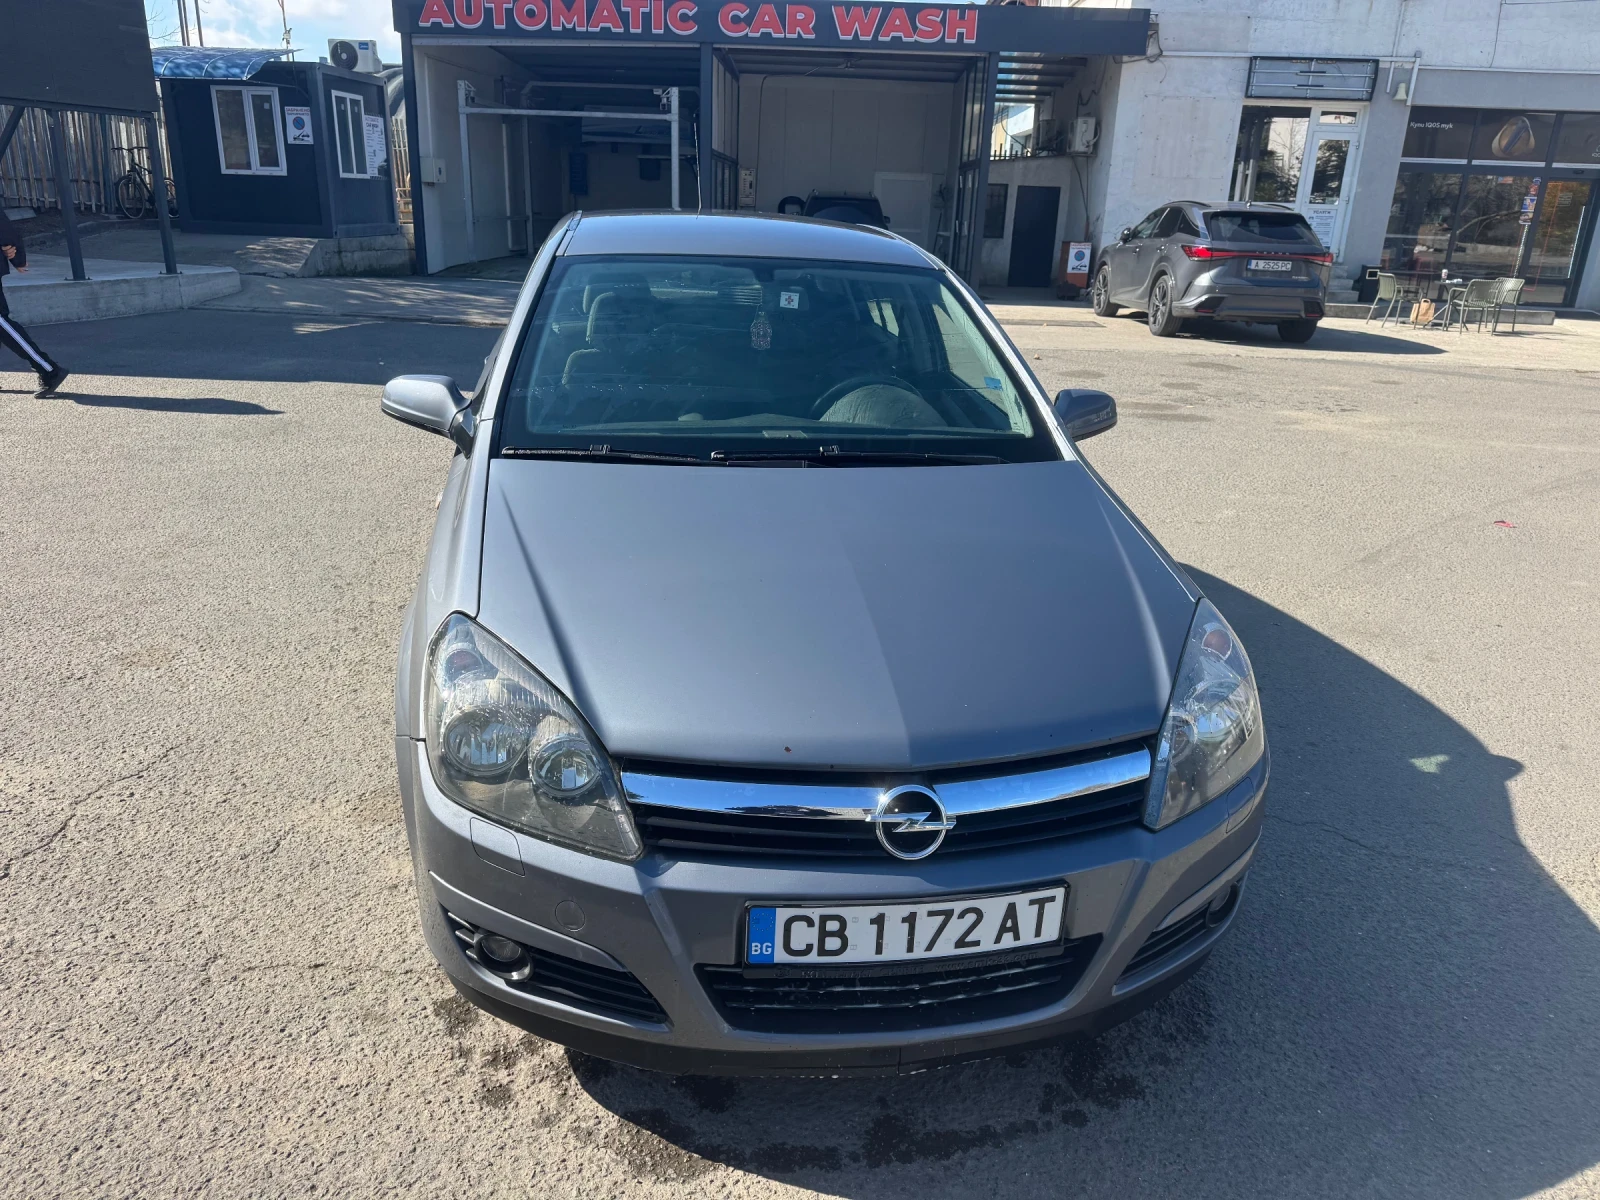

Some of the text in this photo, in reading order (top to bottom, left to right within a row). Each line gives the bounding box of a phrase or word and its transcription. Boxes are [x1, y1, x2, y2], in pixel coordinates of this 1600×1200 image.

[419, 0, 979, 44] AUTOMATIC CAR WASH
[1262, 261, 1280, 269] 2525
[1280, 262, 1291, 270] PC
[782, 896, 1057, 958] CB 1172 AT
[751, 942, 772, 955] BG
